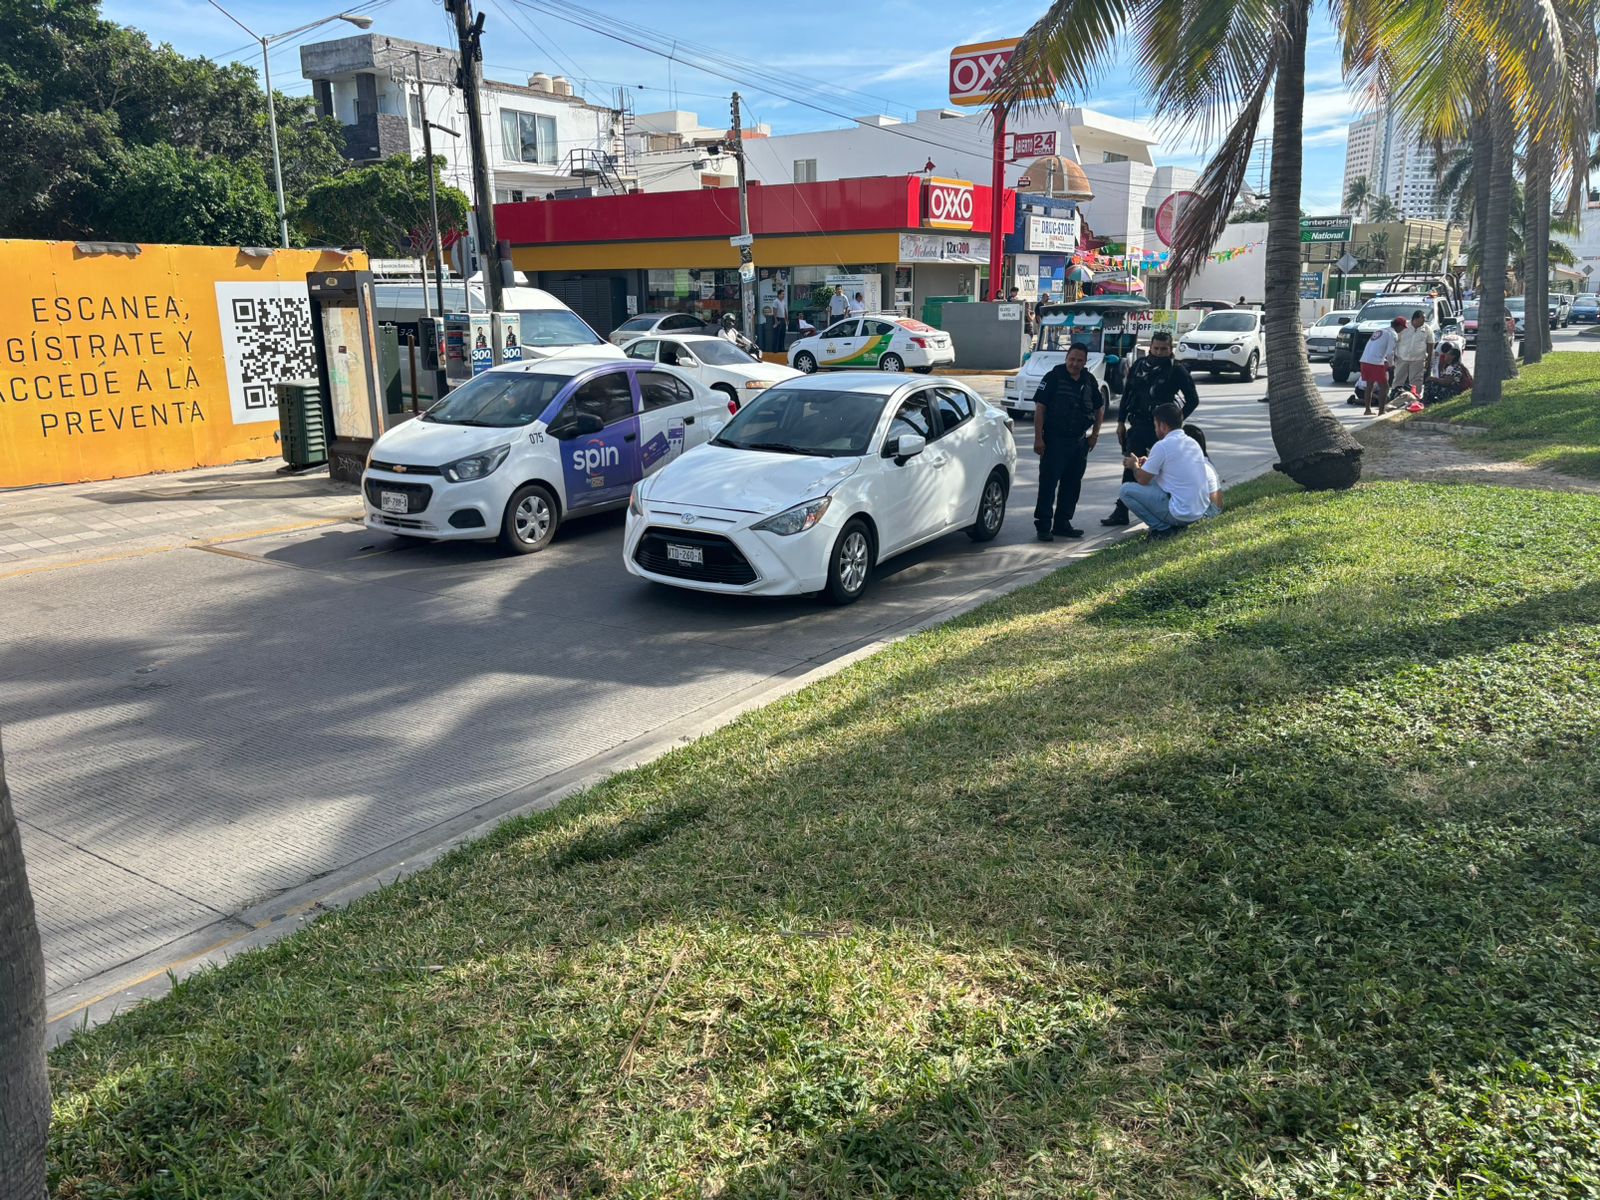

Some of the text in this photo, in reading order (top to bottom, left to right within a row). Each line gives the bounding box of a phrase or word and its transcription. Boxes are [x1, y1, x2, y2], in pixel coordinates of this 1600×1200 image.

[1035, 134, 1054, 149] 24
[931, 187, 973, 221] OXXO
[1041, 220, 1075, 236] DRUG-STORE
[1300, 218, 1349, 226] enterprise
[1311, 231, 1345, 240] National
[32, 295, 190, 323] ESCANEA,
[180, 331, 193, 353] Y
[472, 350, 491, 360] 300
[503, 348, 520, 359] 300
[137, 369, 152, 392] A
[168, 366, 200, 389] LA
[41, 400, 205, 437] PREVENTA
[529, 432, 544, 444] 075
[572, 442, 619, 475] spin
